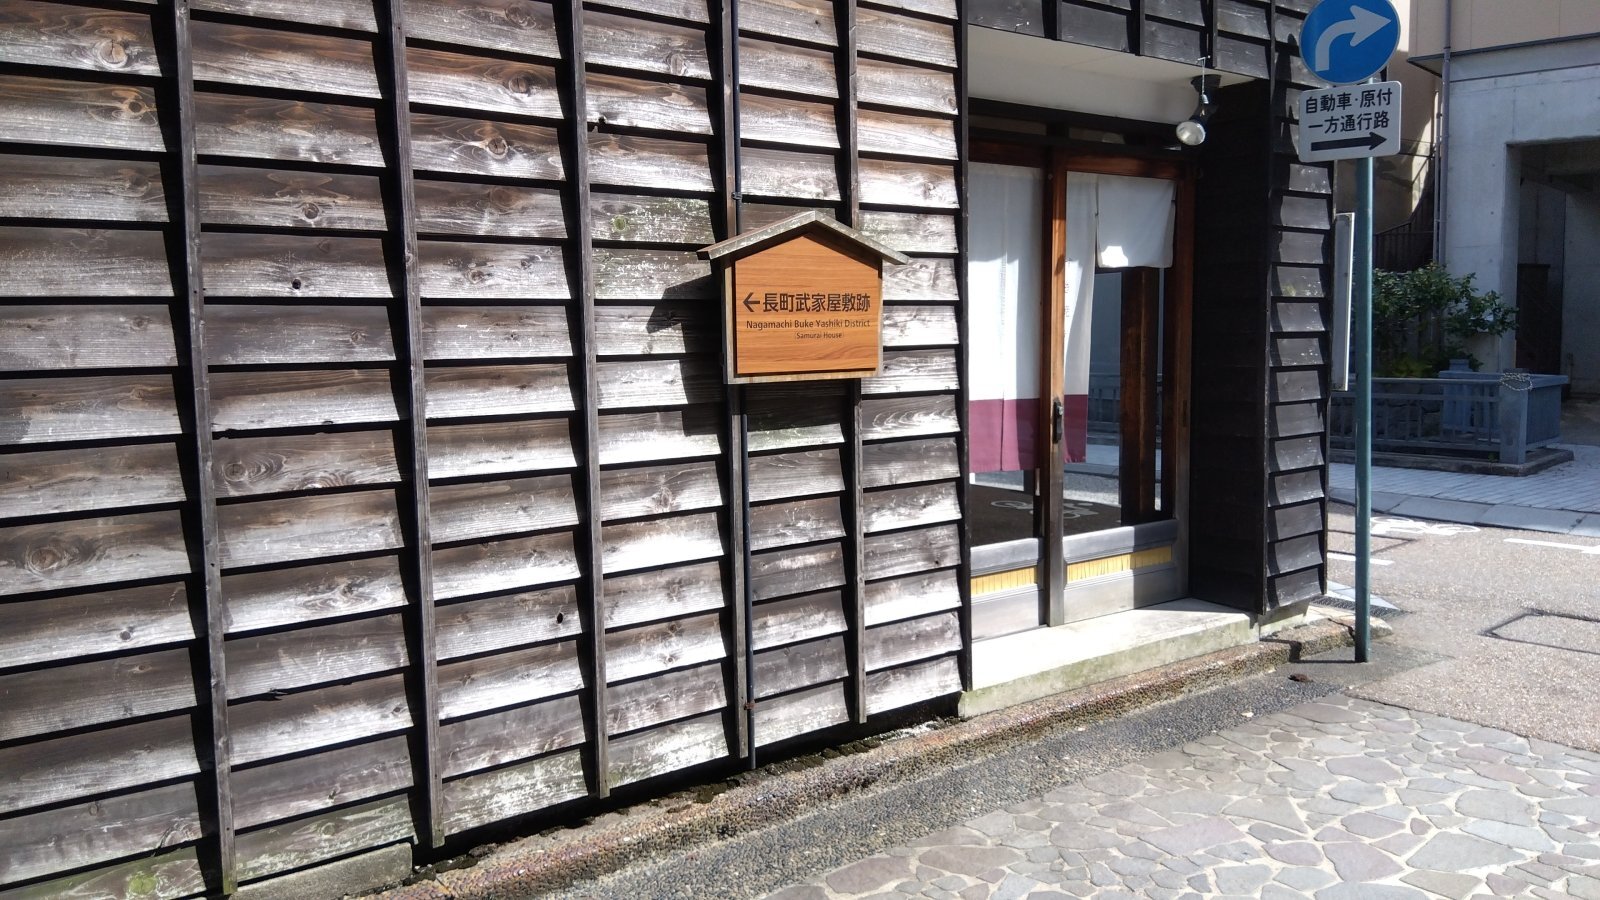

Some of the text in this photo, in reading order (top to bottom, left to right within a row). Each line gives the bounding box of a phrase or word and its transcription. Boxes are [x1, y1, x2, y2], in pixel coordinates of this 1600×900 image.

[1305, 88, 1392, 114] 自動車・原付
[1308, 110, 1390, 134] 一方通行路
[762, 292, 871, 313] 長町武家屋敷跡
[746, 319, 871, 330] Nagamachi Buke Yashiki District
